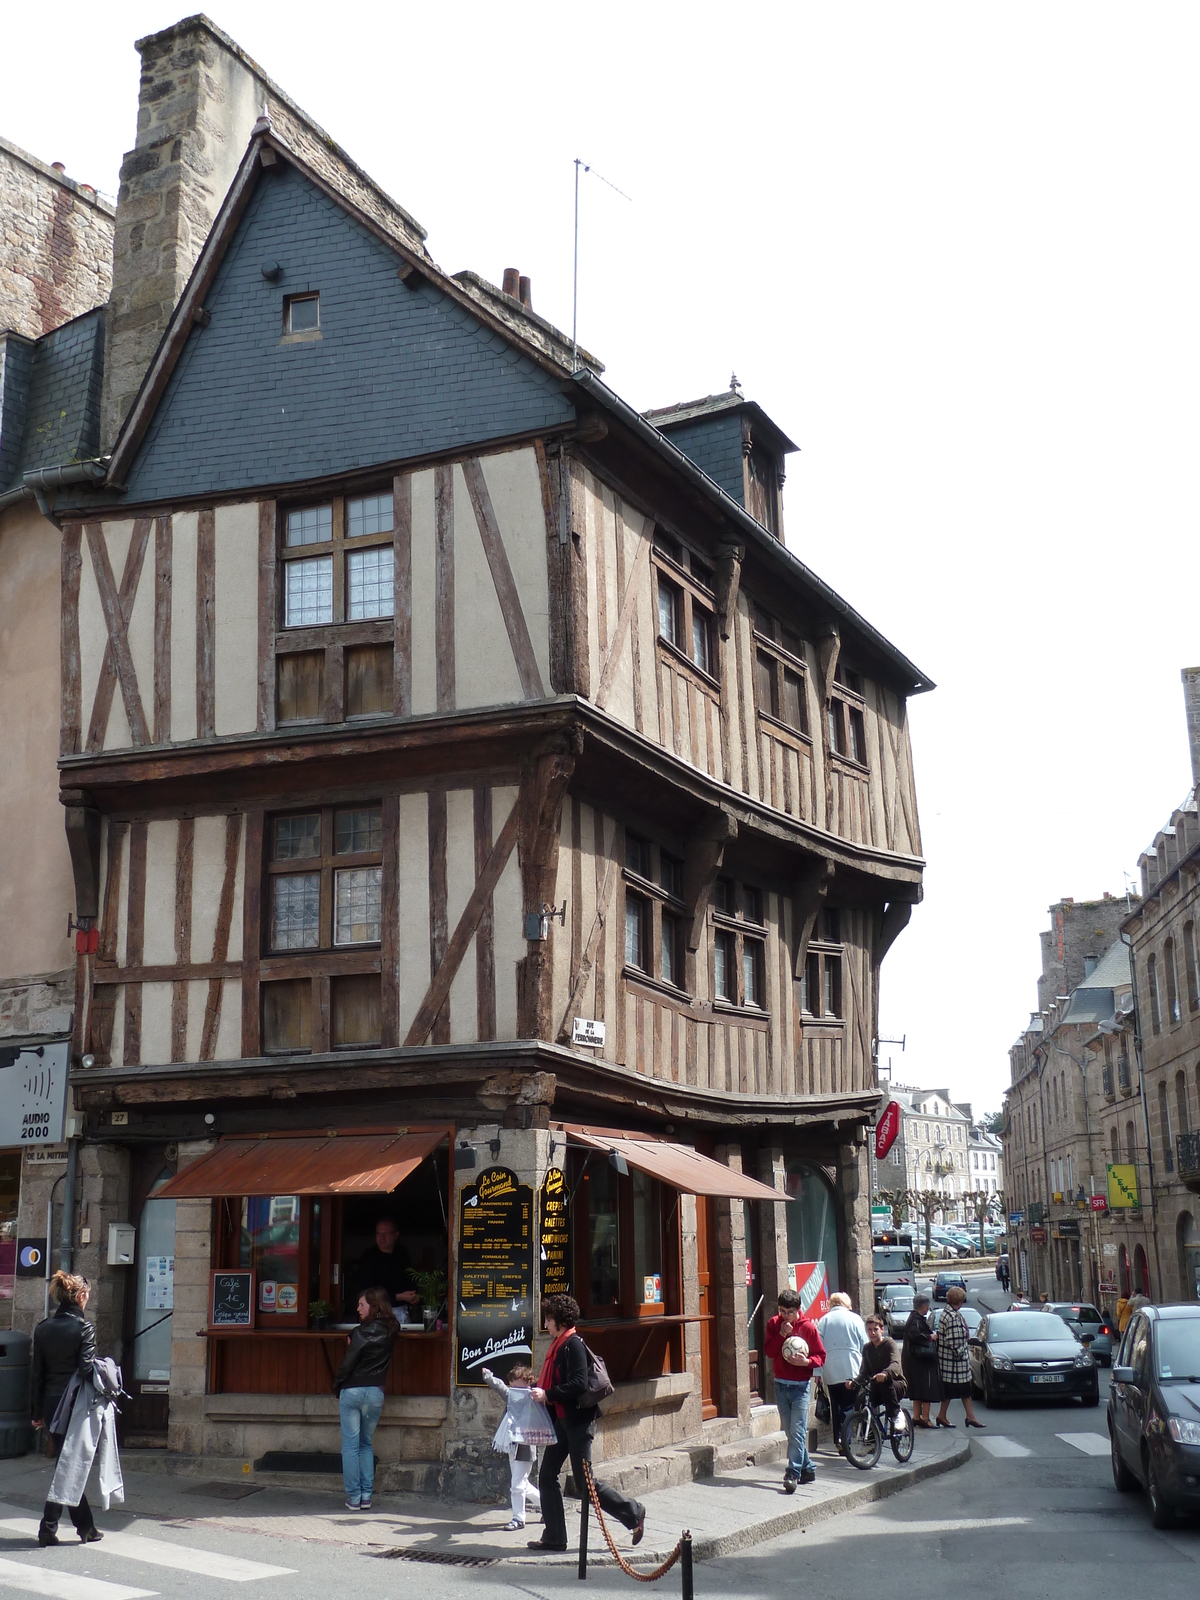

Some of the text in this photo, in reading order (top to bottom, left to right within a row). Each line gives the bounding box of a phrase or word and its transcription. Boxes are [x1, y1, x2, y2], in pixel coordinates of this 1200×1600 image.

[22, 1113, 49, 1125] AUDIO
[21, 1126, 48, 1138] 2000
[878, 1111, 893, 1149] TABAC
[36, 1152, 44, 1160] LA
[482, 1171, 506, 1187] Le Coin
[1107, 1164, 1138, 1206] FLEURS
[479, 1175, 512, 1200] Gourmand
[546, 1201, 563, 1211] CREPES
[1093, 1199, 1105, 1207] SFR
[544, 1217, 565, 1227] GALETTES
[541, 1234, 568, 1244] SANDWICHS
[547, 1250, 564, 1260] PANINI
[546, 1266, 565, 1276] SALADES
[220, 1277, 240, 1292] Café
[544, 1282, 567, 1293] BOISSONS
[802, 1263, 824, 1304] VENDRE
[461, 1326, 525, 1361] Bon Appétit
